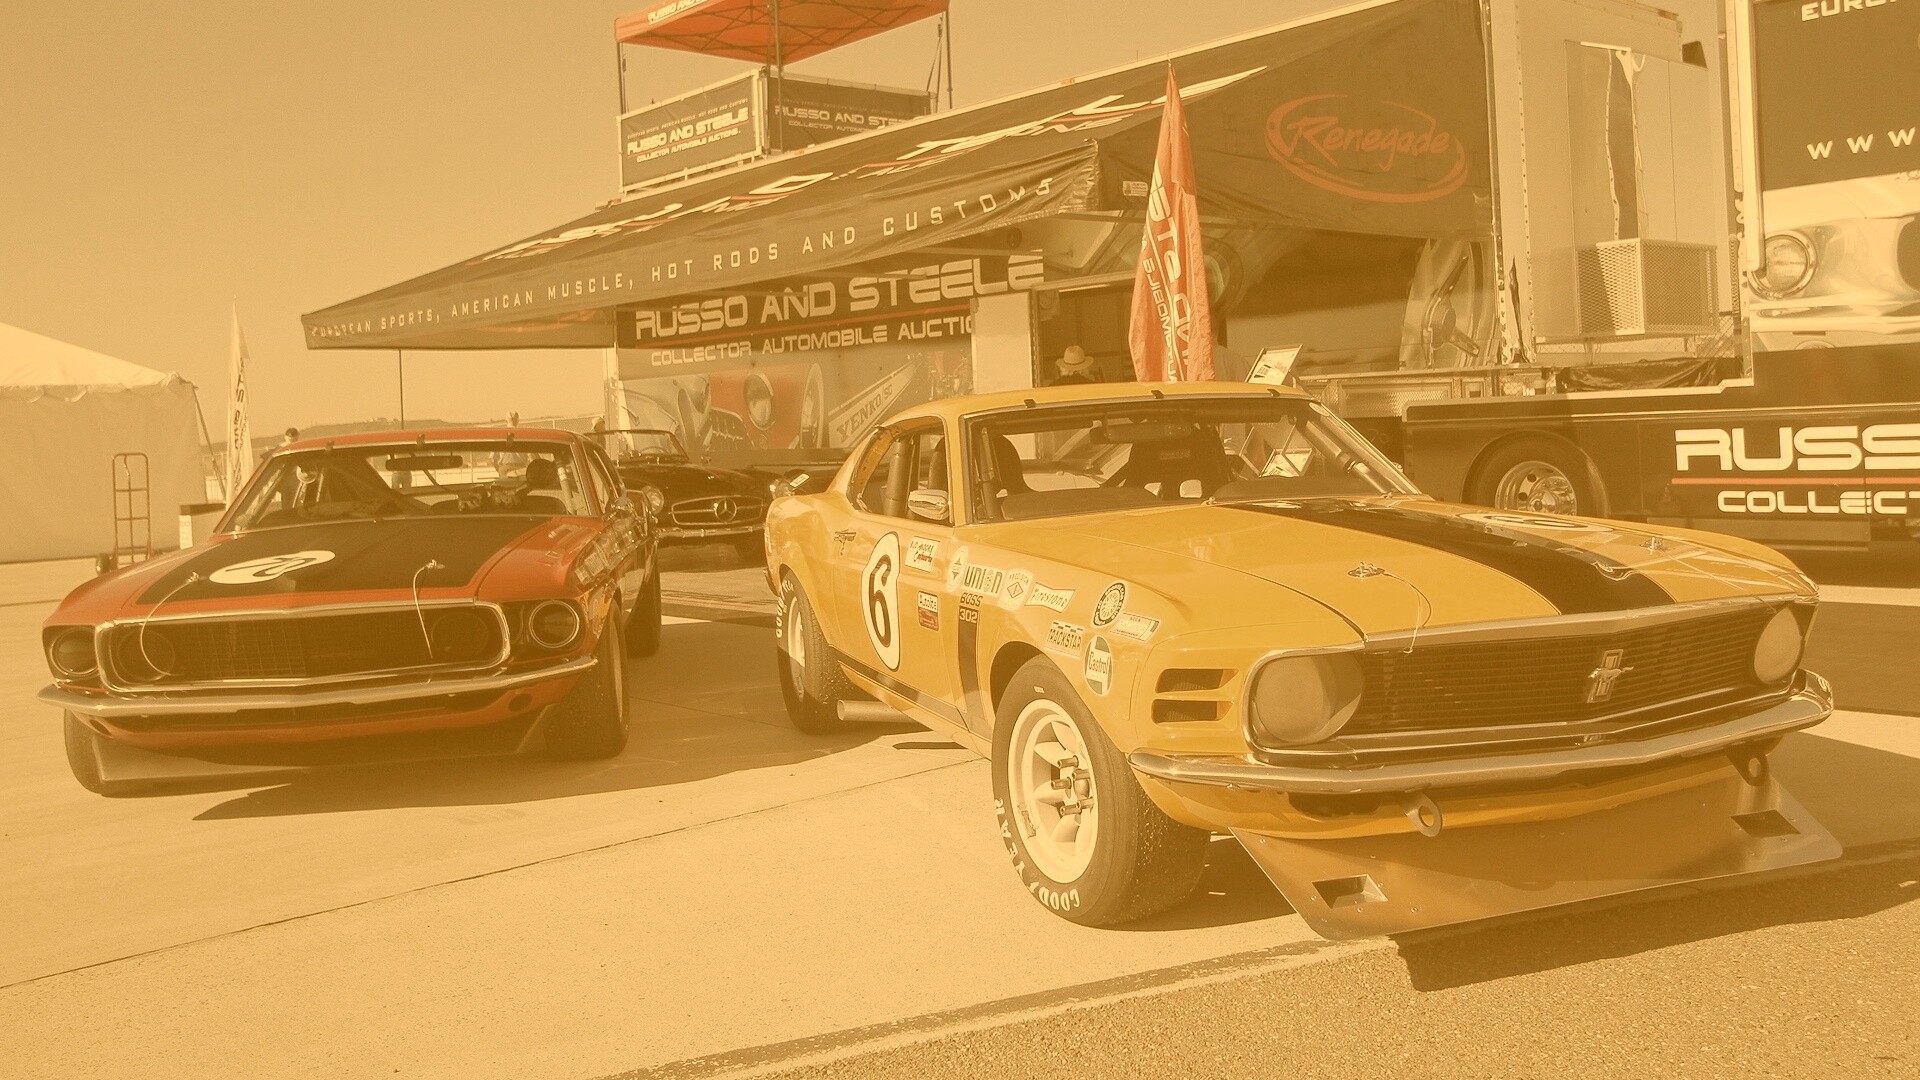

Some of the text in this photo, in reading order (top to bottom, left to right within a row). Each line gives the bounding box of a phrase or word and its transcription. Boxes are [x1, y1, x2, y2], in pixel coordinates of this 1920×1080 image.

[627, 107, 749, 155] RUSSO AND STEELE
[774, 105, 830, 121] RUSSO
[835, 113, 865, 124] AND
[789, 120, 834, 130] COLLECTOR
[637, 148, 670, 163] COLLECTOR
[671, 137, 707, 153] AUTOMOBILE
[1287, 116, 1452, 173] Renegade
[381, 308, 439, 330] SPORTS,
[451, 289, 533, 318] AMERICAN
[547, 271, 634, 300] MUSCLE,
[650, 258, 694, 282] HOT
[712, 242, 779, 271] RODS
[803, 225, 855, 256] AND
[883, 177, 1052, 236] CUSTOMS
[635, 250, 1046, 341] RUSSO AND STEELE
[651, 341, 751, 367] COLLECTOR
[762, 323, 889, 355] AUTOMOBILE
[1675, 424, 1920, 471] RUSS
[868, 554, 891, 648] 6
[959, 607, 978, 623] 302
[960, 592, 984, 607] BOSS
[1047, 628, 1082, 651] TRACKSTAR
[1088, 650, 1110, 675] Castrol
[994, 798, 1081, 911] GOODYEAR
